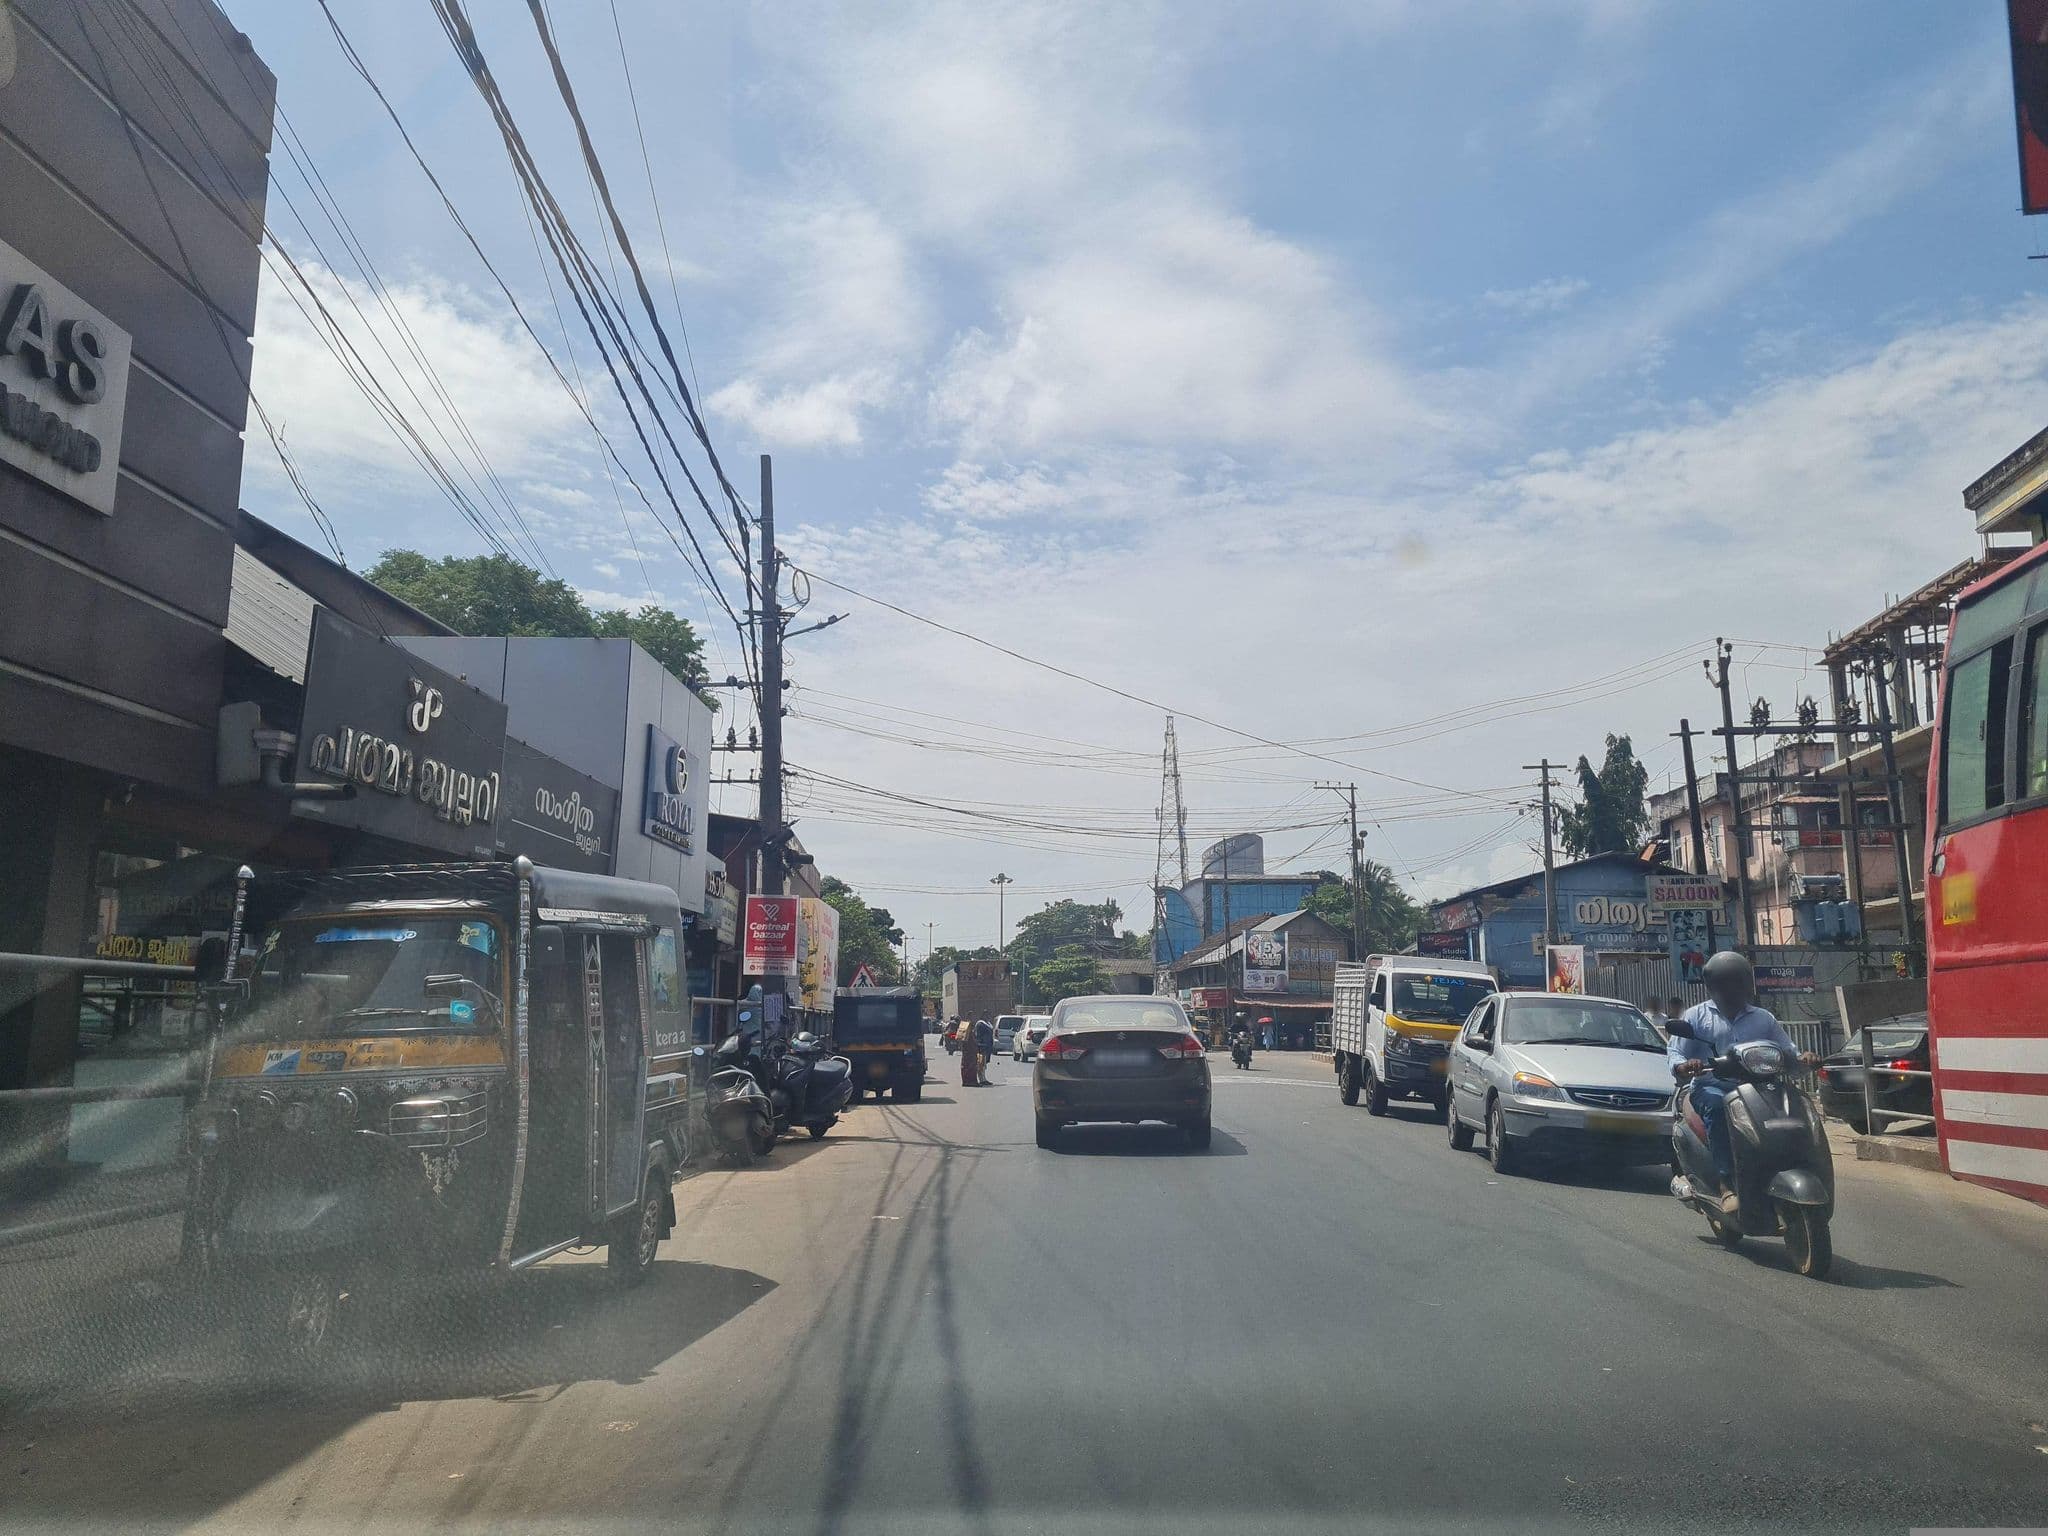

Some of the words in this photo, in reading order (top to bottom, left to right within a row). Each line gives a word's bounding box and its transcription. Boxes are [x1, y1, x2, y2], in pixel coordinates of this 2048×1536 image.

[535, 786, 595, 834] സംഗീത
[658, 791, 694, 836] ROYAL
[1654, 885, 1720, 901] SALOON
[752, 929, 787, 939] bazaar
